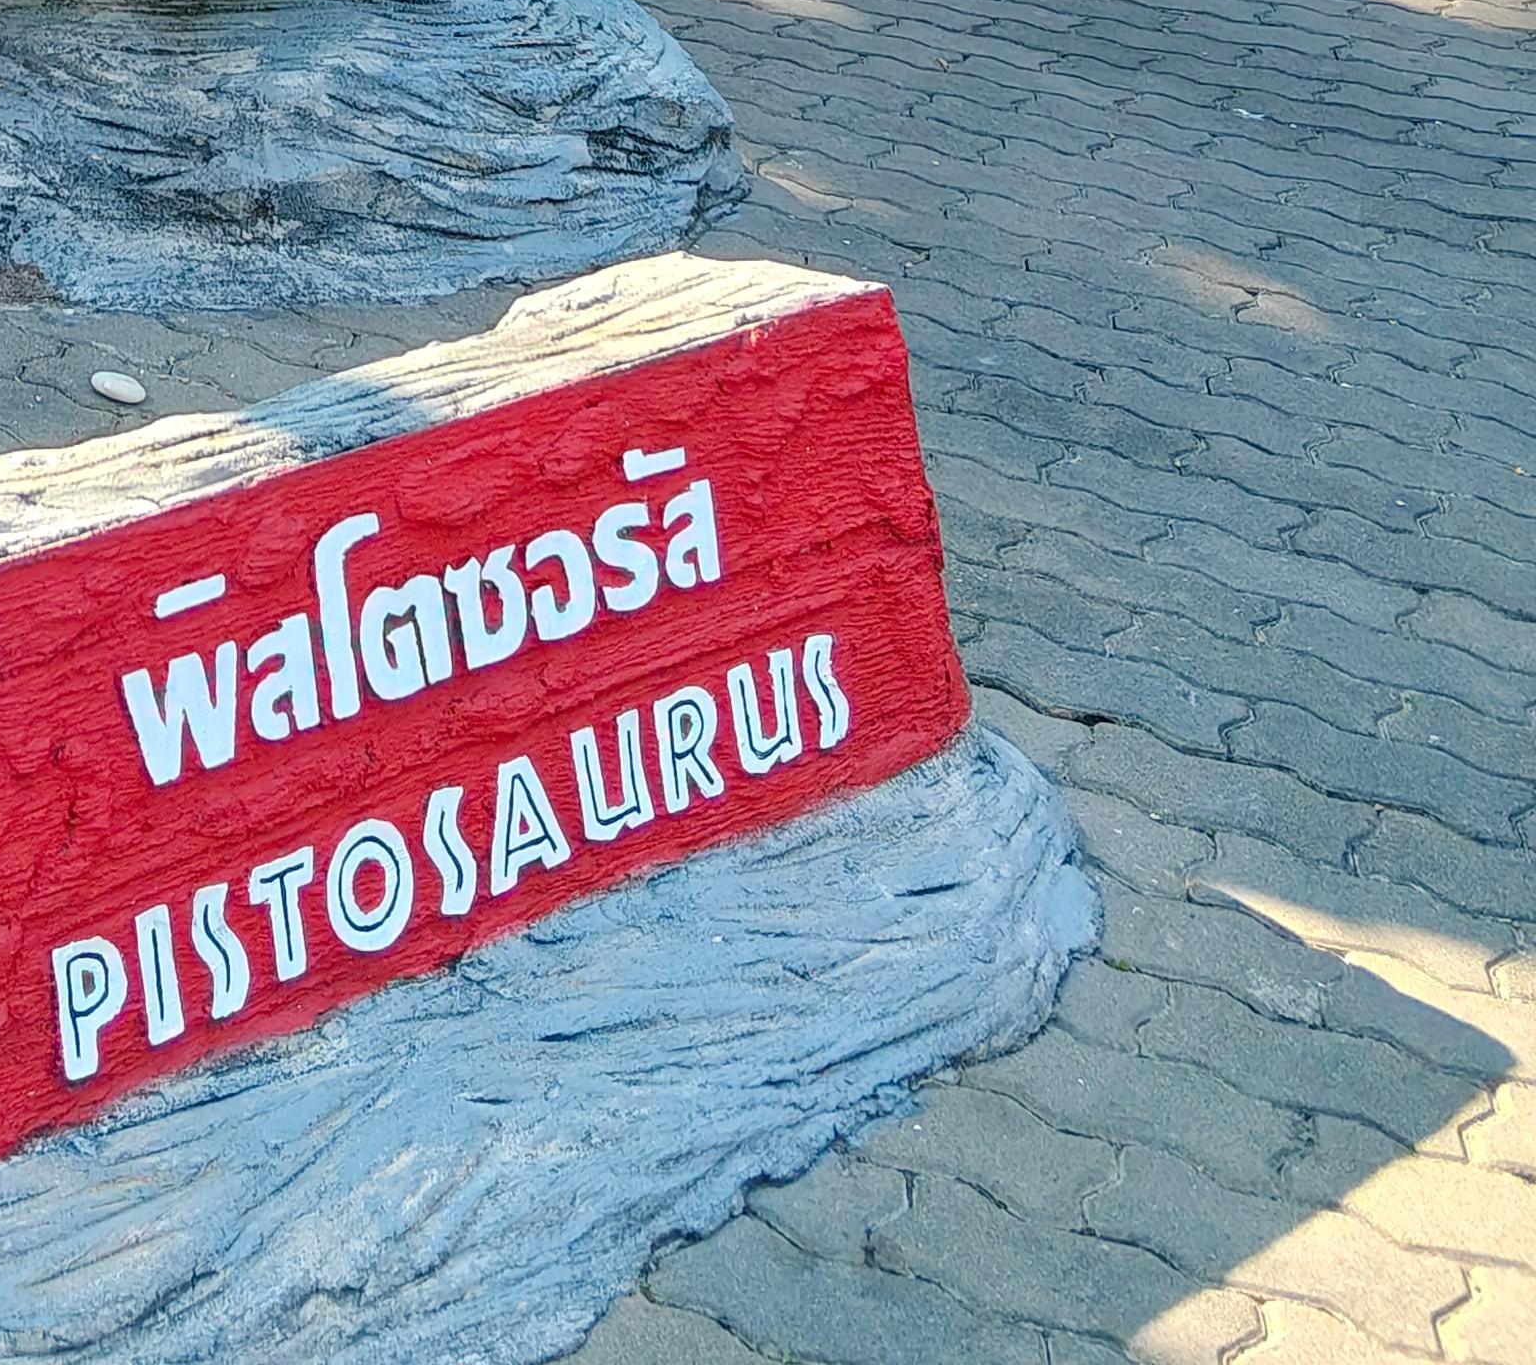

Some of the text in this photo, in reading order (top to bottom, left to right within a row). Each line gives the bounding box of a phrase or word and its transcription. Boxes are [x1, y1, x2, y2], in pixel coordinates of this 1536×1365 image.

[120, 445, 723, 787] พิสโตซอรัส
[51, 633, 851, 1081] PISTOSAURUS
